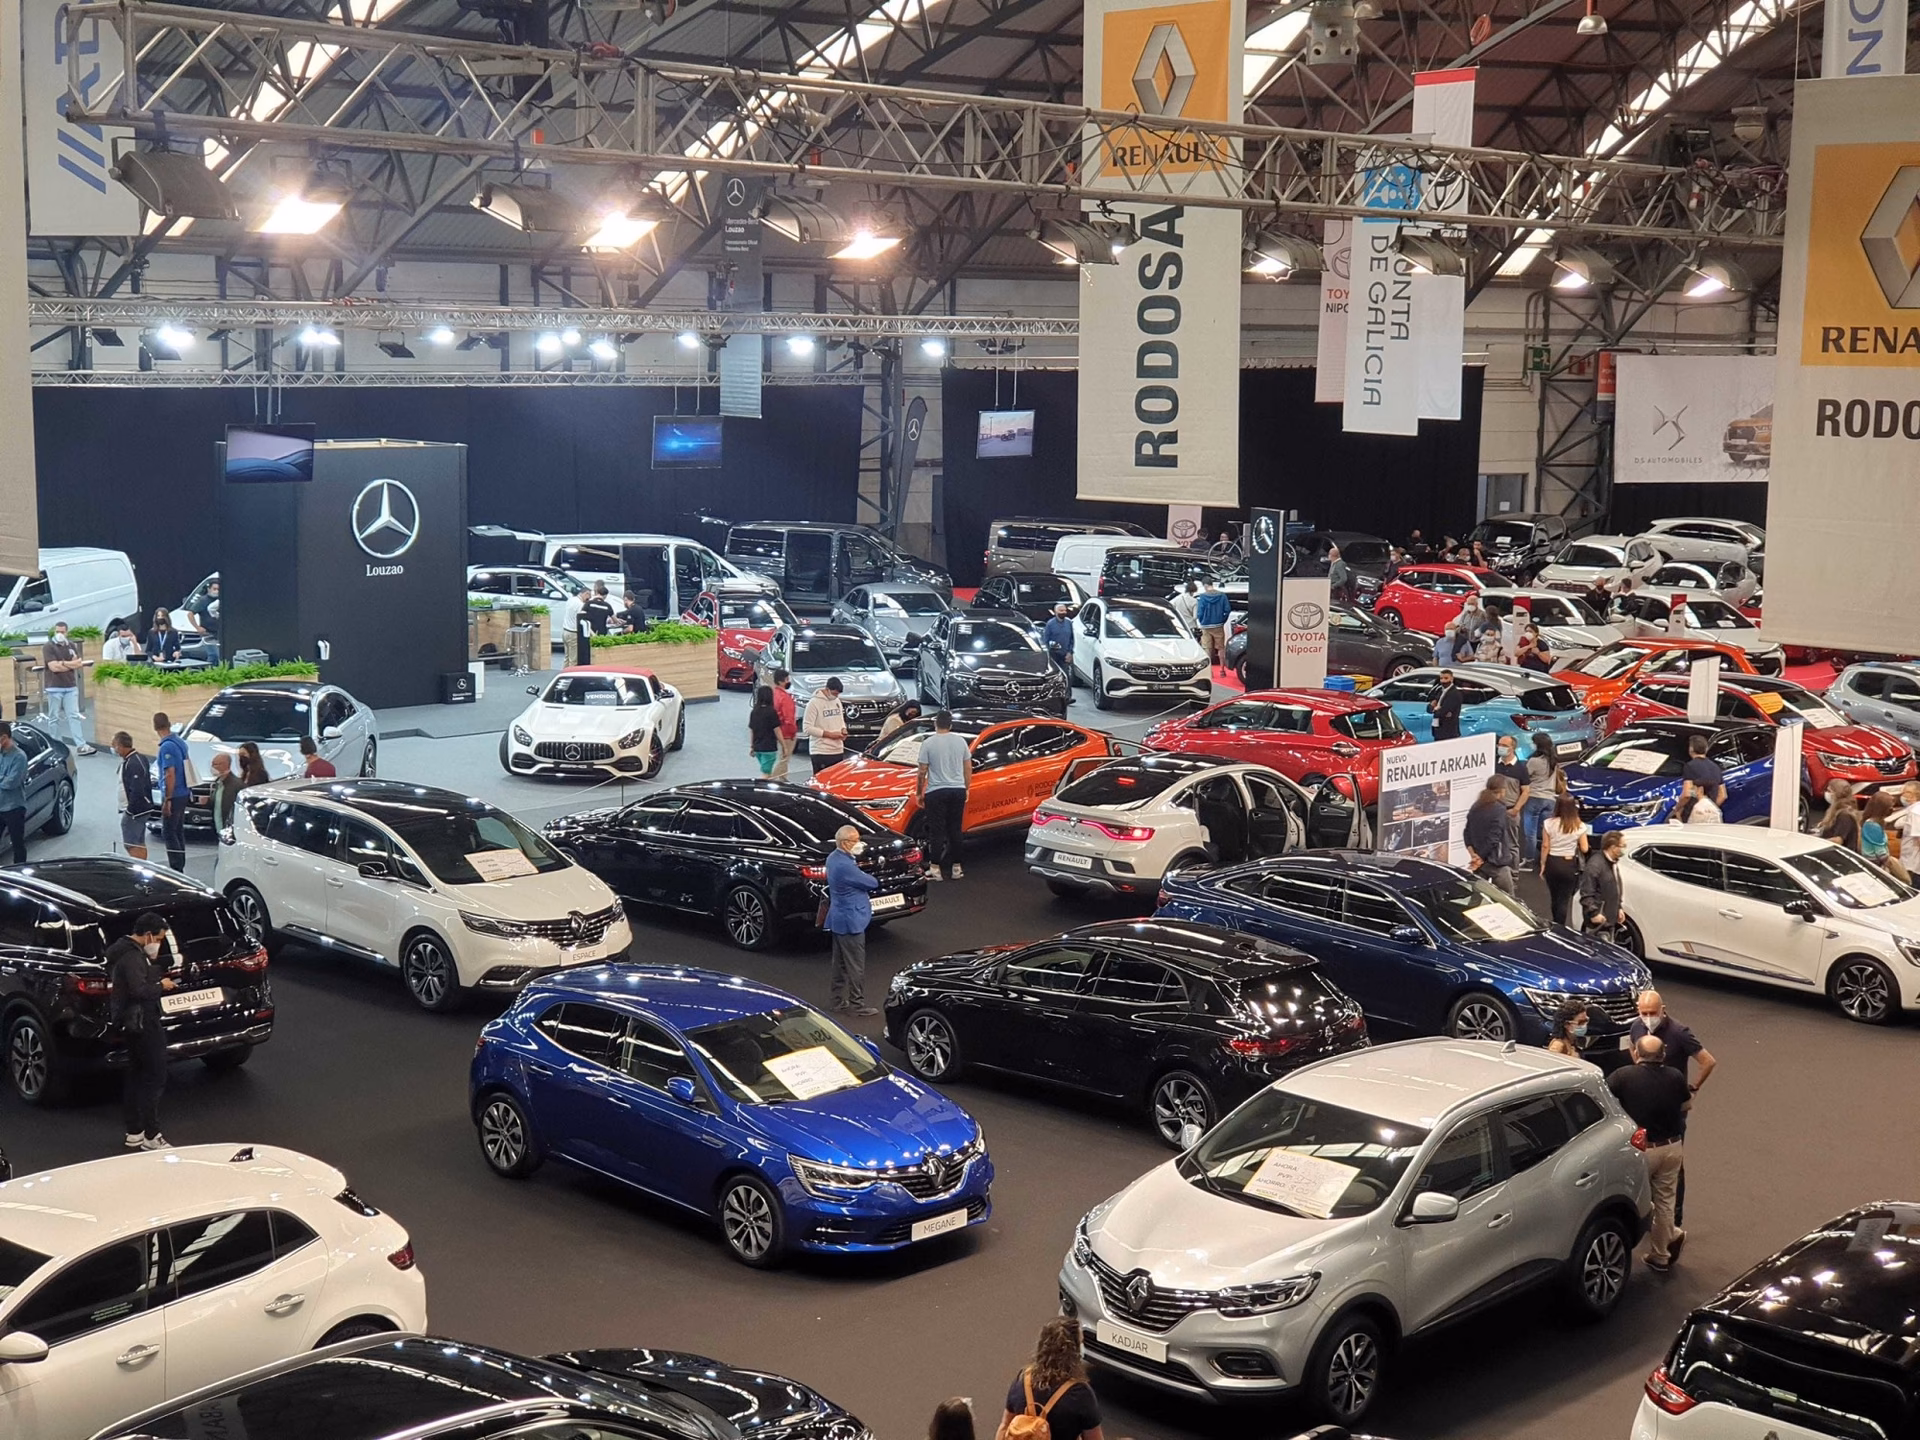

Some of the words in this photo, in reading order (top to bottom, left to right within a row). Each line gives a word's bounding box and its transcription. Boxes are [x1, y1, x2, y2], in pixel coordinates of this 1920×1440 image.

[1370, 235, 1389, 272] DE
[1390, 257, 1412, 341] UNTA
[1134, 205, 1185, 470] RODOSA
[1363, 281, 1387, 406] GALICIA
[1821, 326, 1920, 353] RENA
[1816, 398, 1920, 440] RODO
[366, 564, 404, 576] Louzao
[1284, 632, 1326, 642] TOYOTA
[1286, 645, 1323, 655] Nipocar
[1386, 754, 1408, 765] NUEVO
[1386, 761, 1437, 783] RENAULT
[1439, 752, 1487, 774] ARKANA
[1057, 853, 1088, 865] RENAULT
[572, 949, 597, 961] ESPACE
[168, 991, 217, 1007] RENAULT
[923, 1216, 956, 1234] MEGANE
[1111, 1332, 1149, 1354] KADJAR
